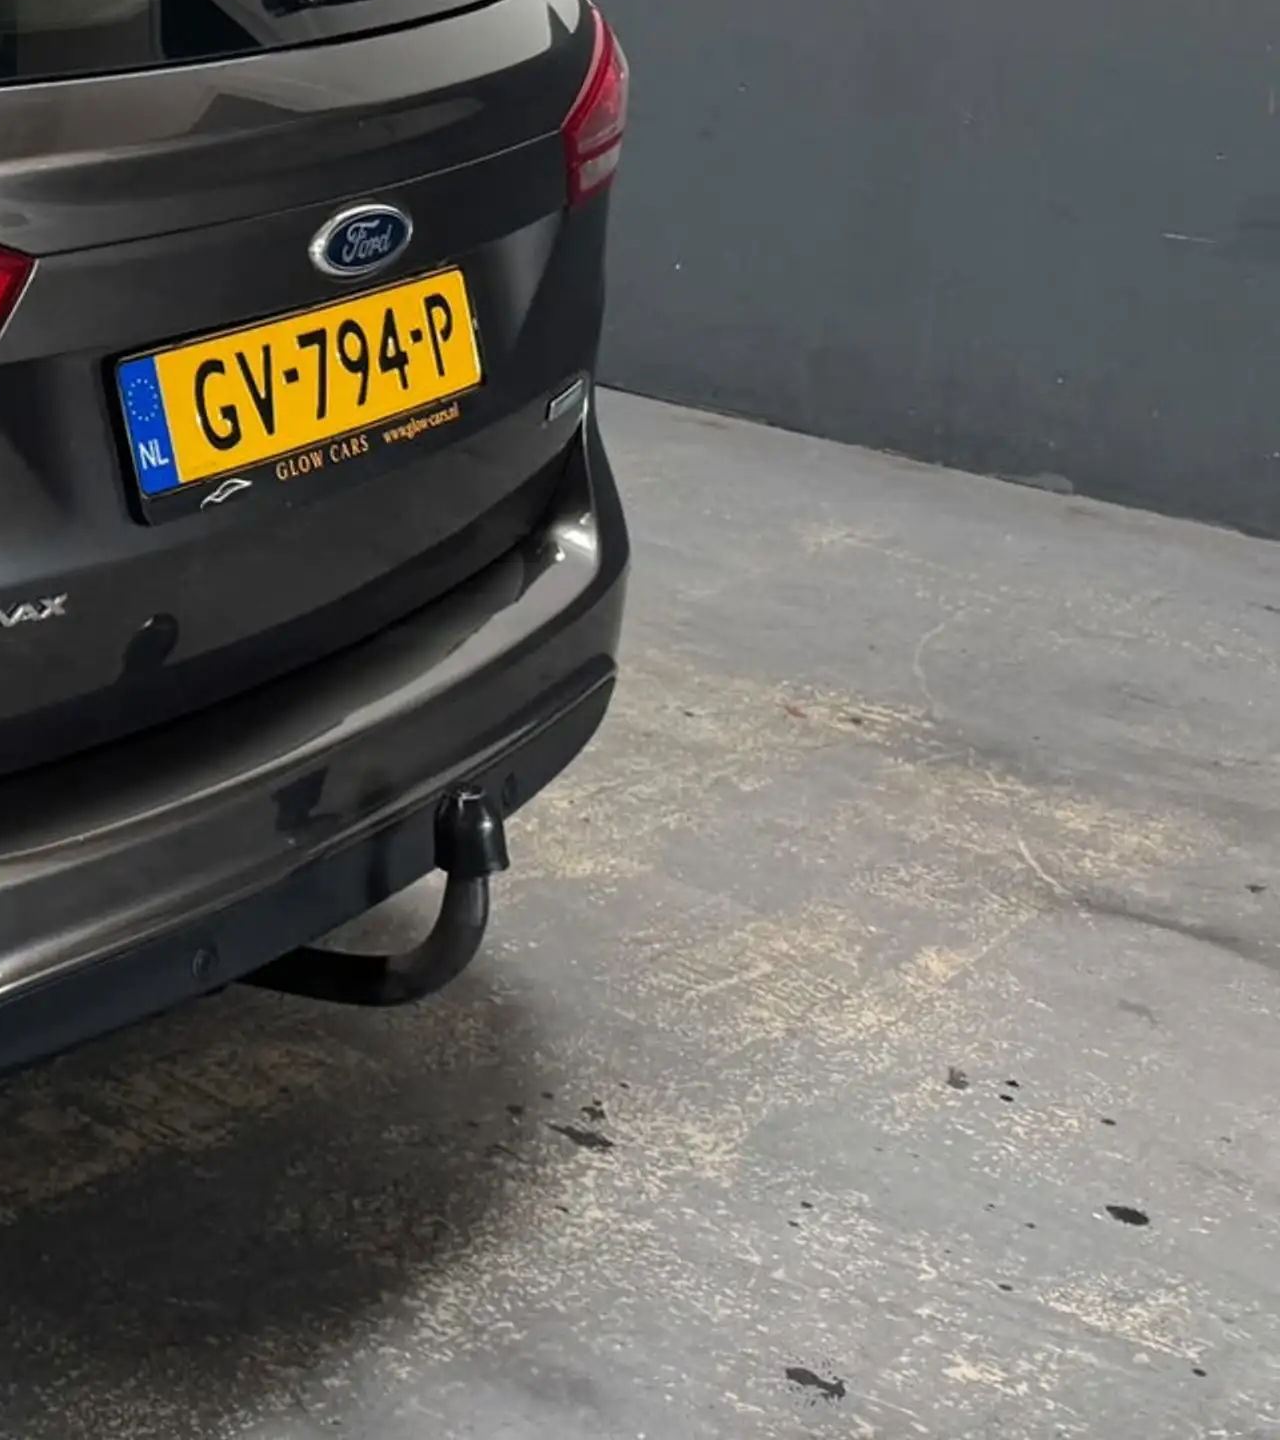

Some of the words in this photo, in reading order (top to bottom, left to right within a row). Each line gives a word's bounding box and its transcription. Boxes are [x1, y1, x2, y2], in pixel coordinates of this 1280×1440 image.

[341, 219, 393, 264] Ford
[195, 292, 453, 451] GV-794-P
[138, 438, 170, 470] NL
[275, 449, 324, 481] GLOW
[329, 433, 370, 464] CARS
